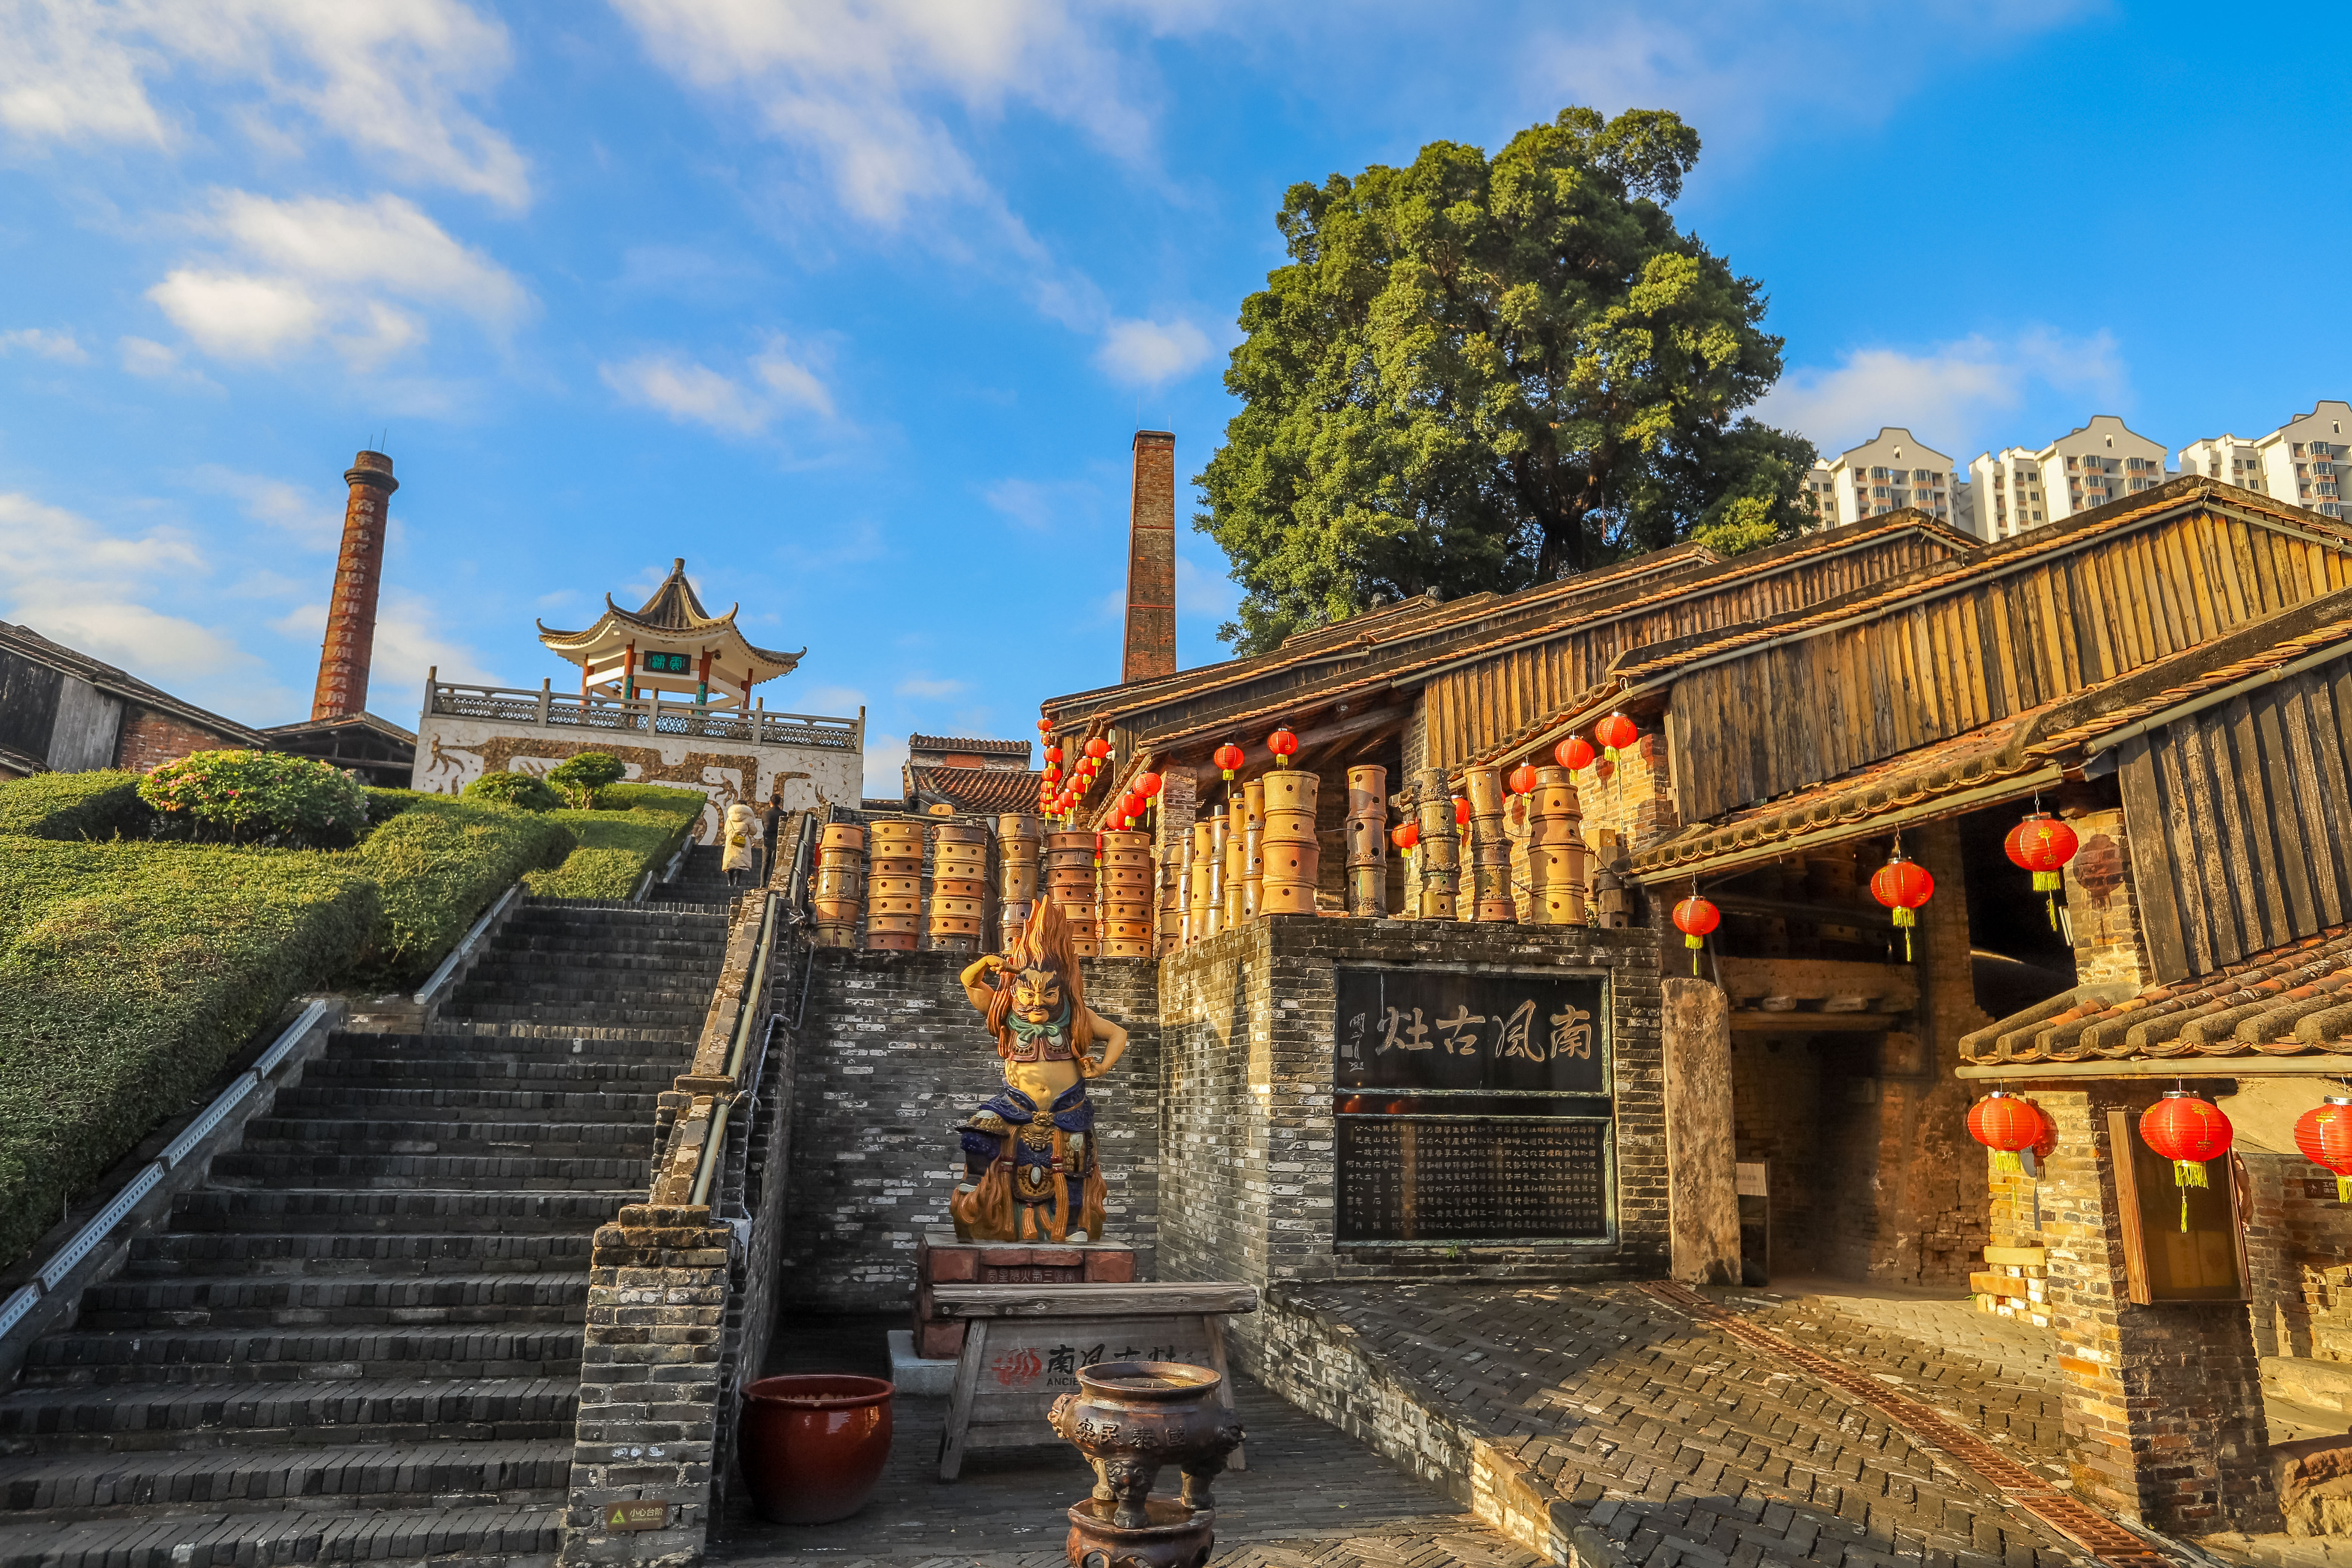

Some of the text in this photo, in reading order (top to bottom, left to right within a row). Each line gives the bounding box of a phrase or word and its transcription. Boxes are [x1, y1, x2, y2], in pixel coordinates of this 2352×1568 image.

[1047, 1378, 1078, 1386] ANCIE
[630, 1507, 663, 1517] 小心台阶
